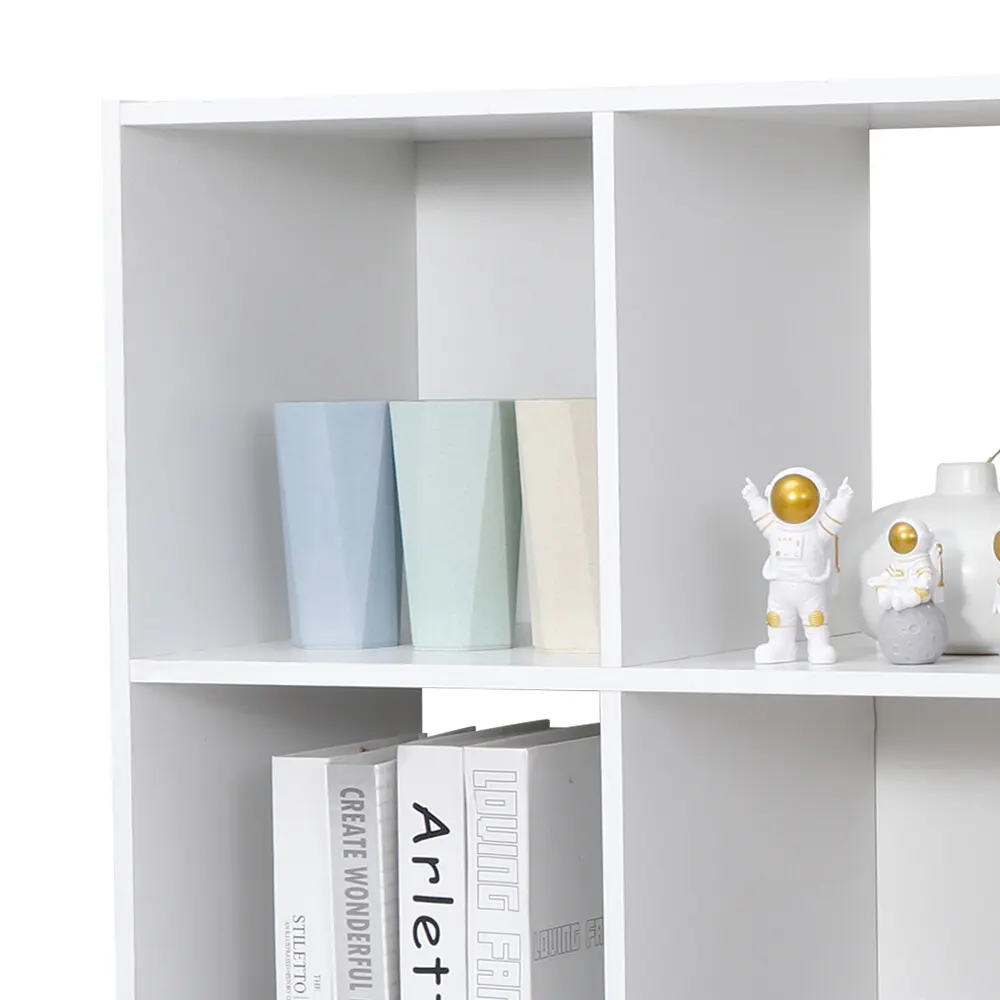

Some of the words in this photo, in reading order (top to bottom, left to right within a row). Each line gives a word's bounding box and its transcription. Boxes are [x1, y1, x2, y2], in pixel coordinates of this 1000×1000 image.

[340, 787, 367, 859] CREATE
[473, 770, 520, 912] LOVING
[293, 915, 307, 994] STILETTO
[344, 866, 373, 991] WONDERFUL
[533, 921, 581, 961] LOVING
